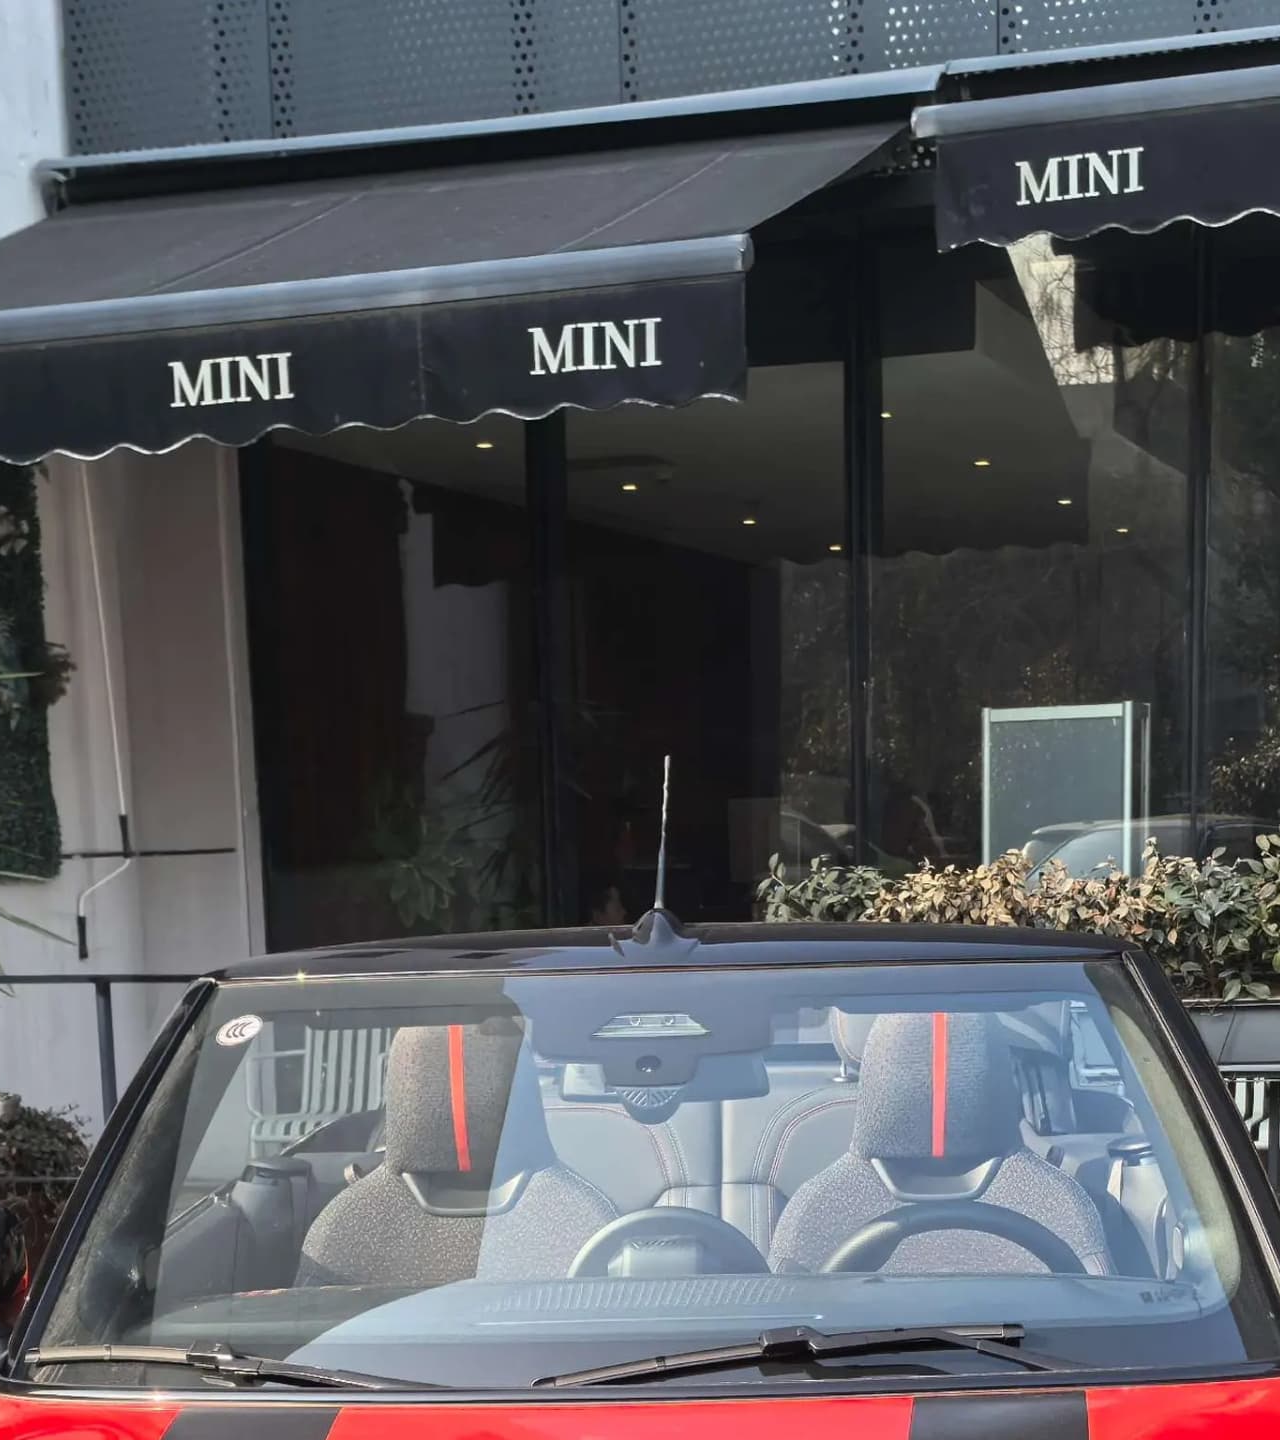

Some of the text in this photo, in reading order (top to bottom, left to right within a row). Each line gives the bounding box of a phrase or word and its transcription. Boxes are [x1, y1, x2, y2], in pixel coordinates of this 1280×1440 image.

[1014, 146, 1145, 206] MINI
[527, 317, 662, 376] MINI
[167, 352, 295, 408] MINI
